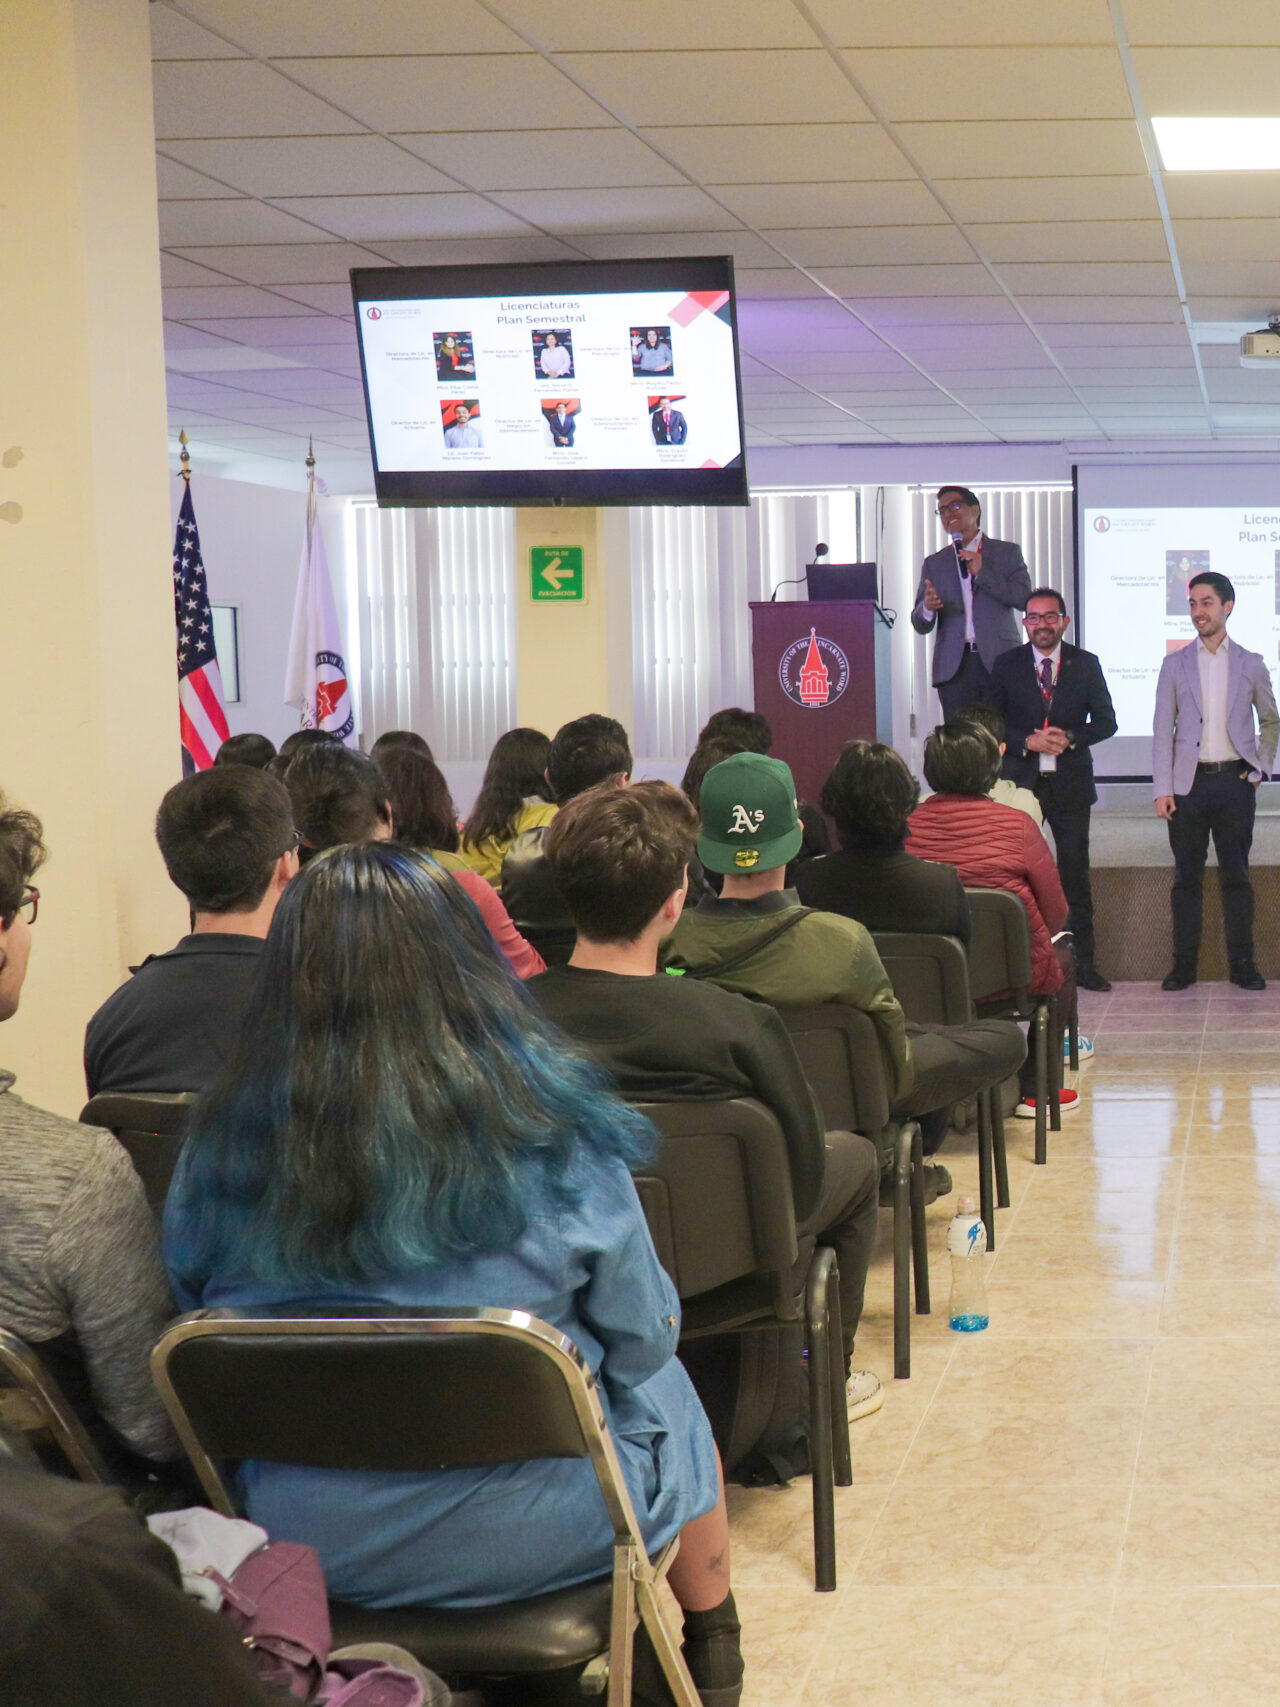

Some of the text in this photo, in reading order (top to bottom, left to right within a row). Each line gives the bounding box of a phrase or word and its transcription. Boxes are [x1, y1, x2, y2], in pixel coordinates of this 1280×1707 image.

[500, 301, 580, 312] Licenciaturas
[497, 313, 586, 325] Plan Semestral
[1238, 531, 1267, 543] Plan
[781, 640, 847, 693] UNIVERSITY OF THE INCARNATE WORD
[727, 804, 765, 834] A's
